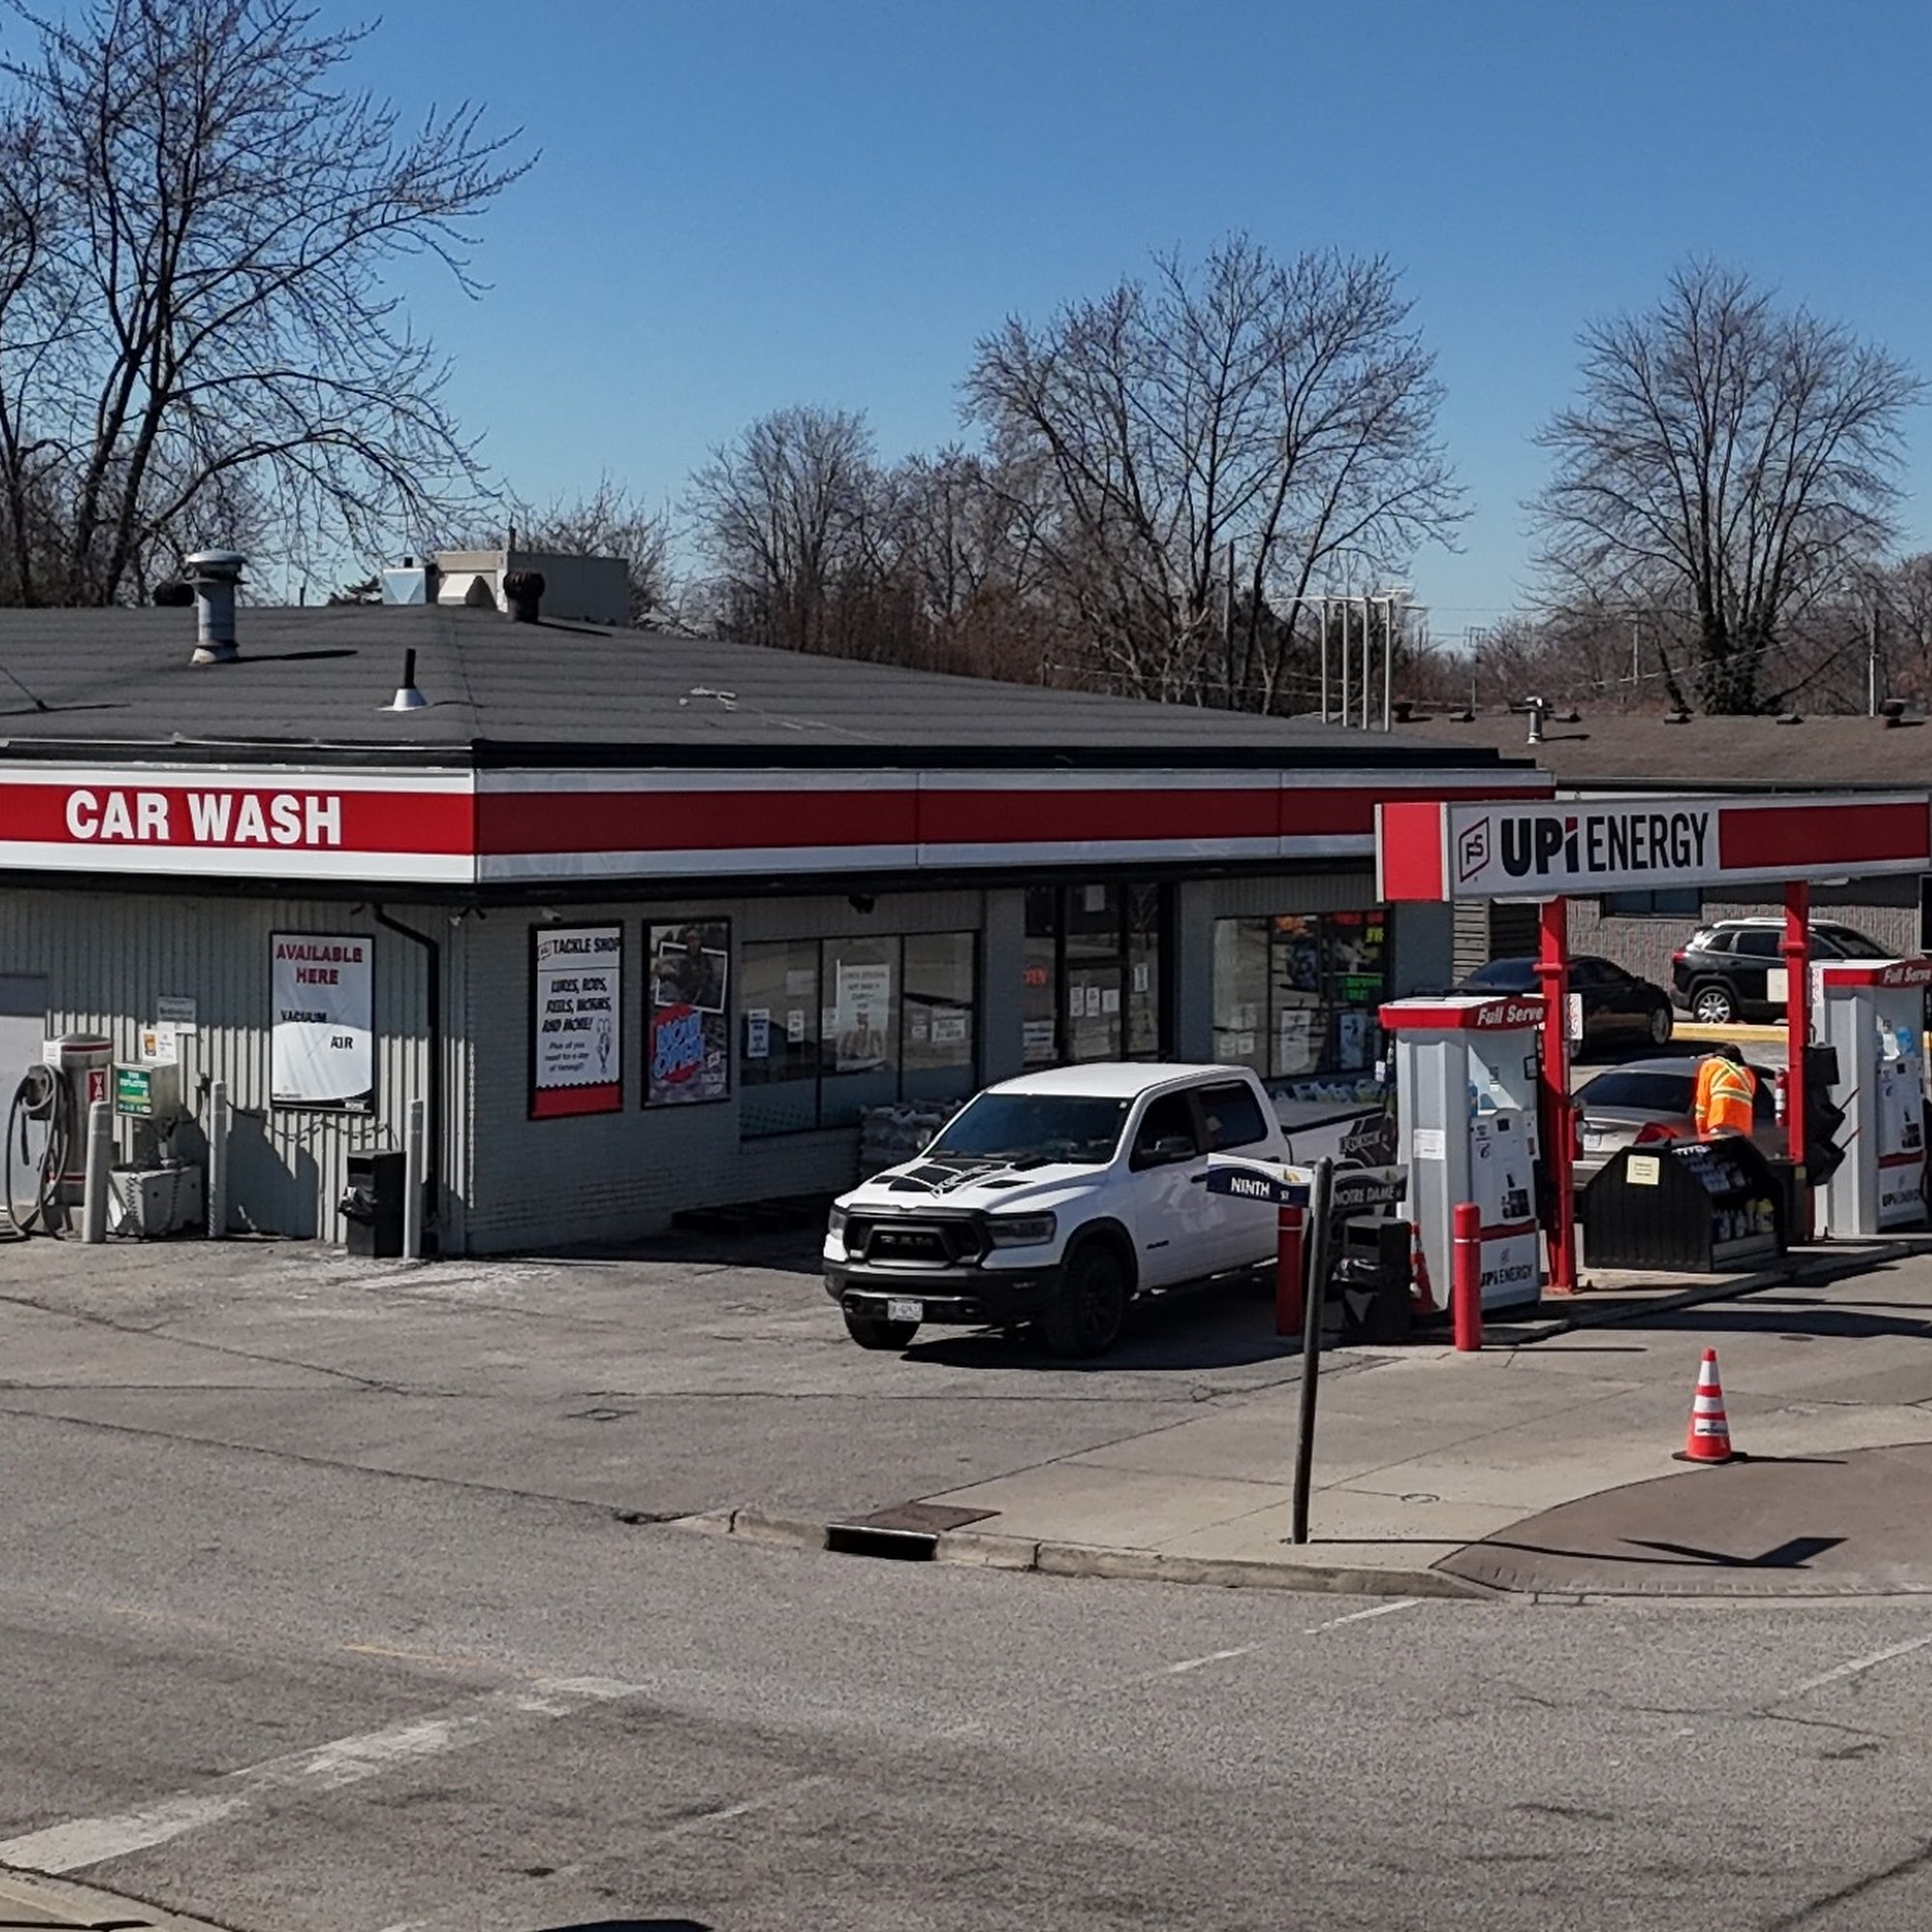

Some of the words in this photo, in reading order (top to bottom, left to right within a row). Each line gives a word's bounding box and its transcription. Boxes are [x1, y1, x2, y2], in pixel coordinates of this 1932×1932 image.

[66, 789, 170, 839] CAR
[187, 793, 341, 844] WASH
[1587, 811, 1709, 872] ENERGY
[276, 943, 363, 963] AVAILABLE
[553, 938, 590, 954] TACKLE
[296, 967, 339, 984] HERE
[280, 1010, 327, 1023] VACUUM
[1477, 1008, 1503, 1026] Full
[1507, 1005, 1545, 1023] Serve
[330, 1036, 354, 1049] AIR
[1231, 1177, 1270, 1197] NINTH
[1366, 1184, 1394, 1202] DAME
[880, 1236, 935, 1247] RAM
